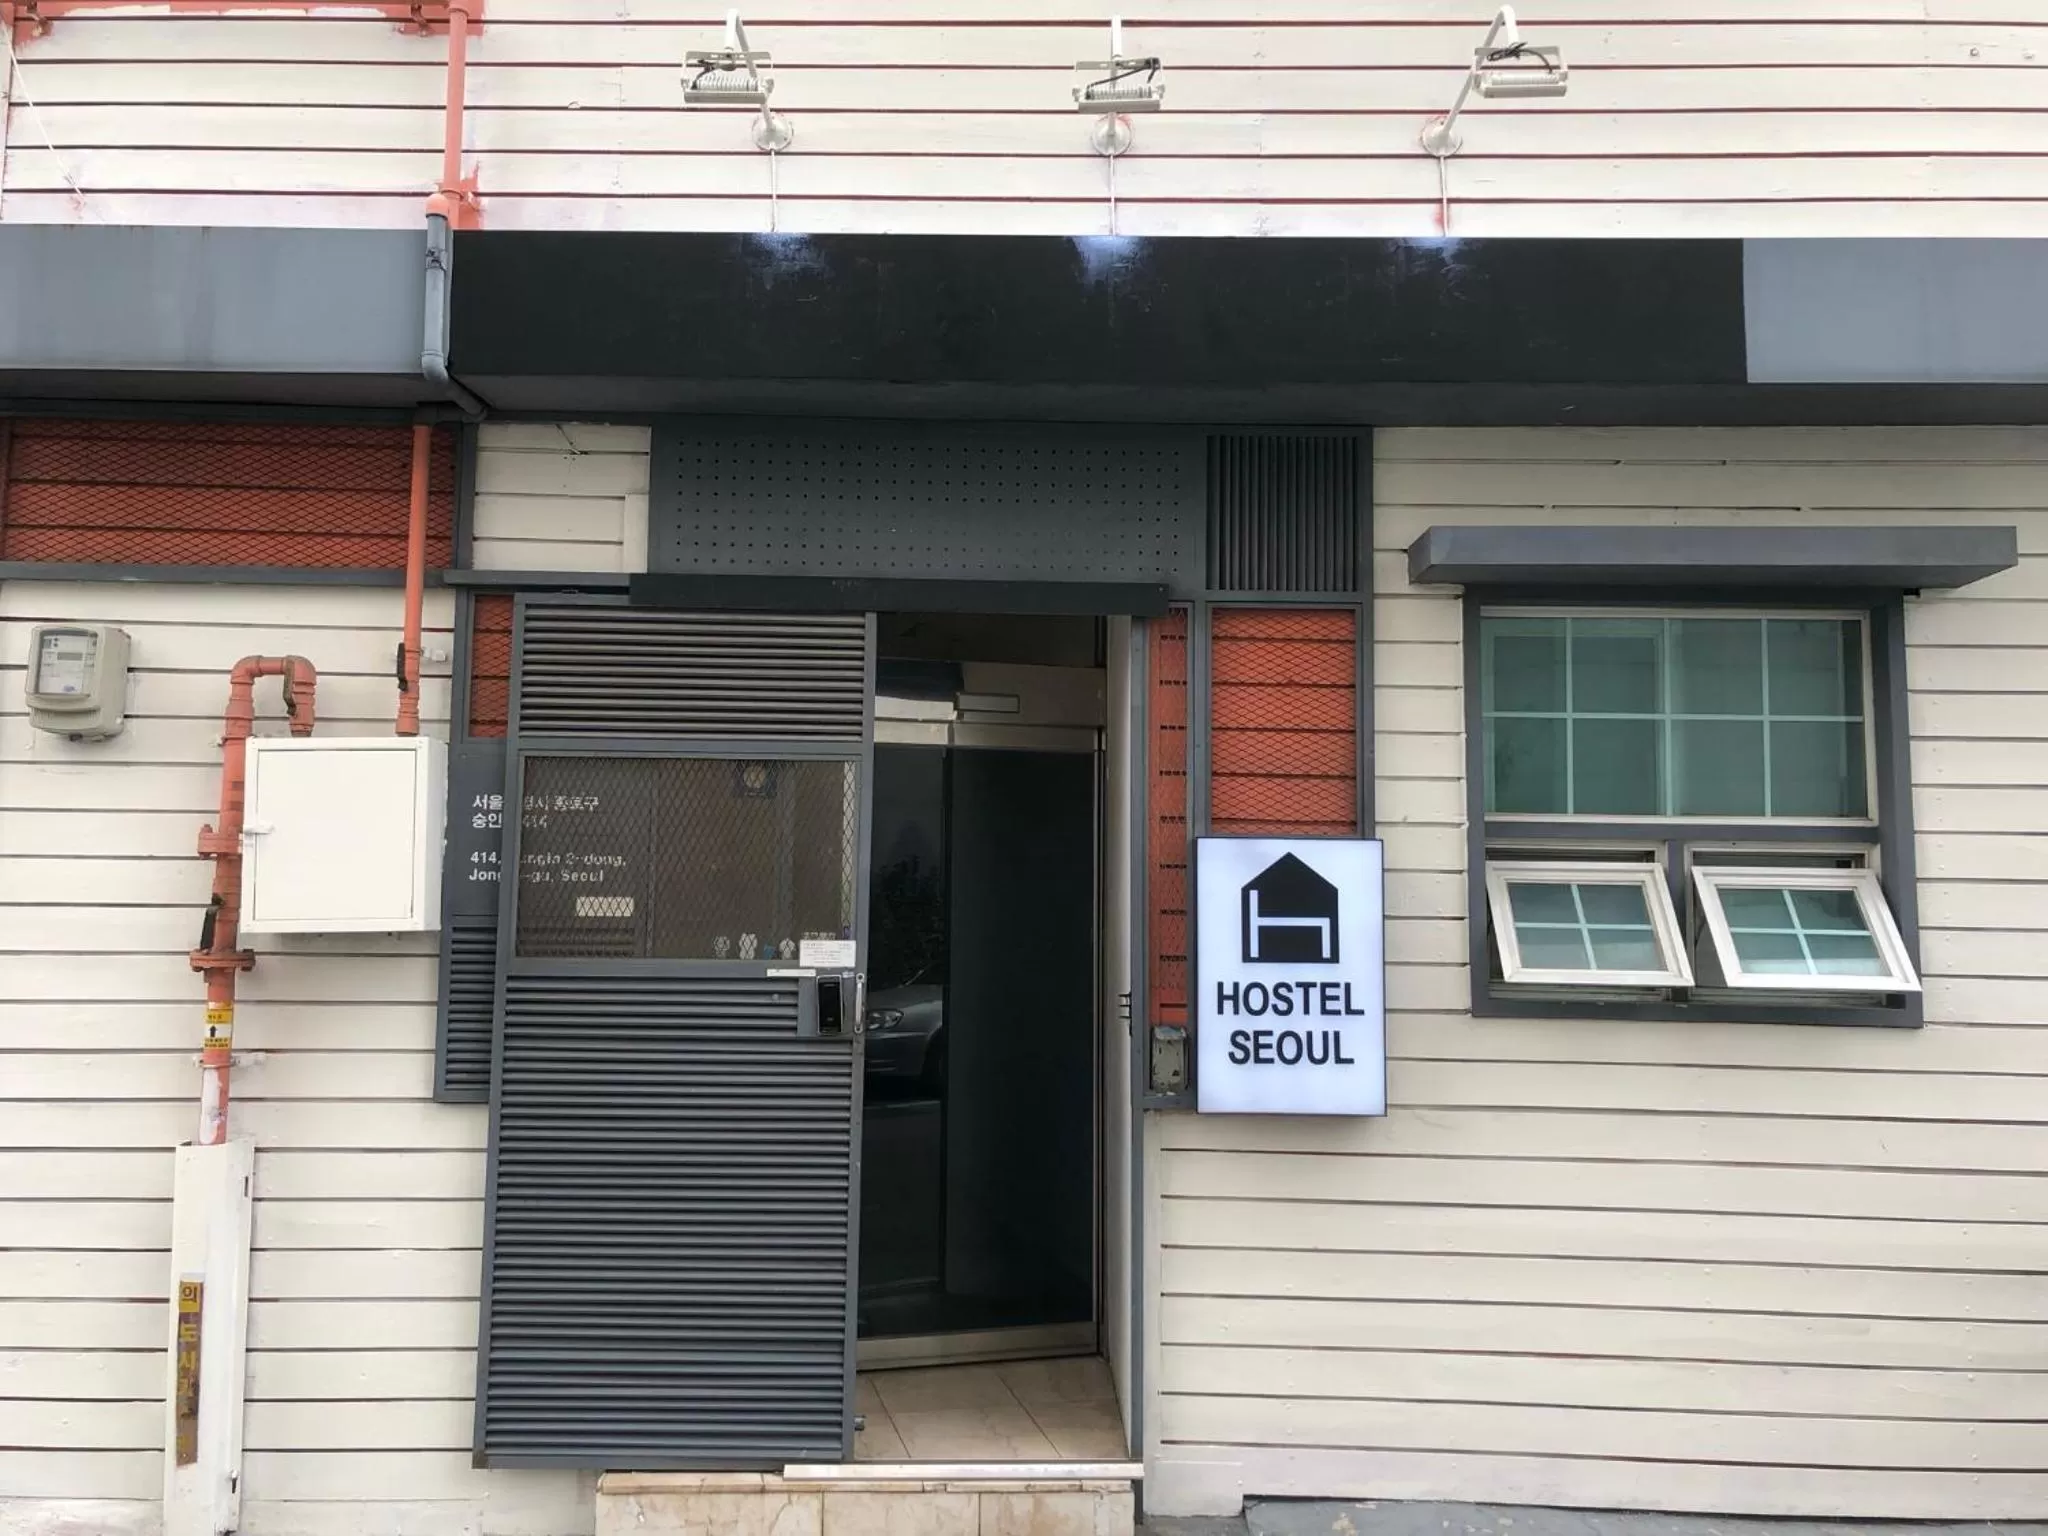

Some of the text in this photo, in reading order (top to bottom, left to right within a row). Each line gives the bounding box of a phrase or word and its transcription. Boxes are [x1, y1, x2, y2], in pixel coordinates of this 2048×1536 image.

[561, 870, 604, 882] Seoul
[1216, 981, 1365, 1016] HOSTEL
[1228, 1029, 1355, 1065] SEOUL
